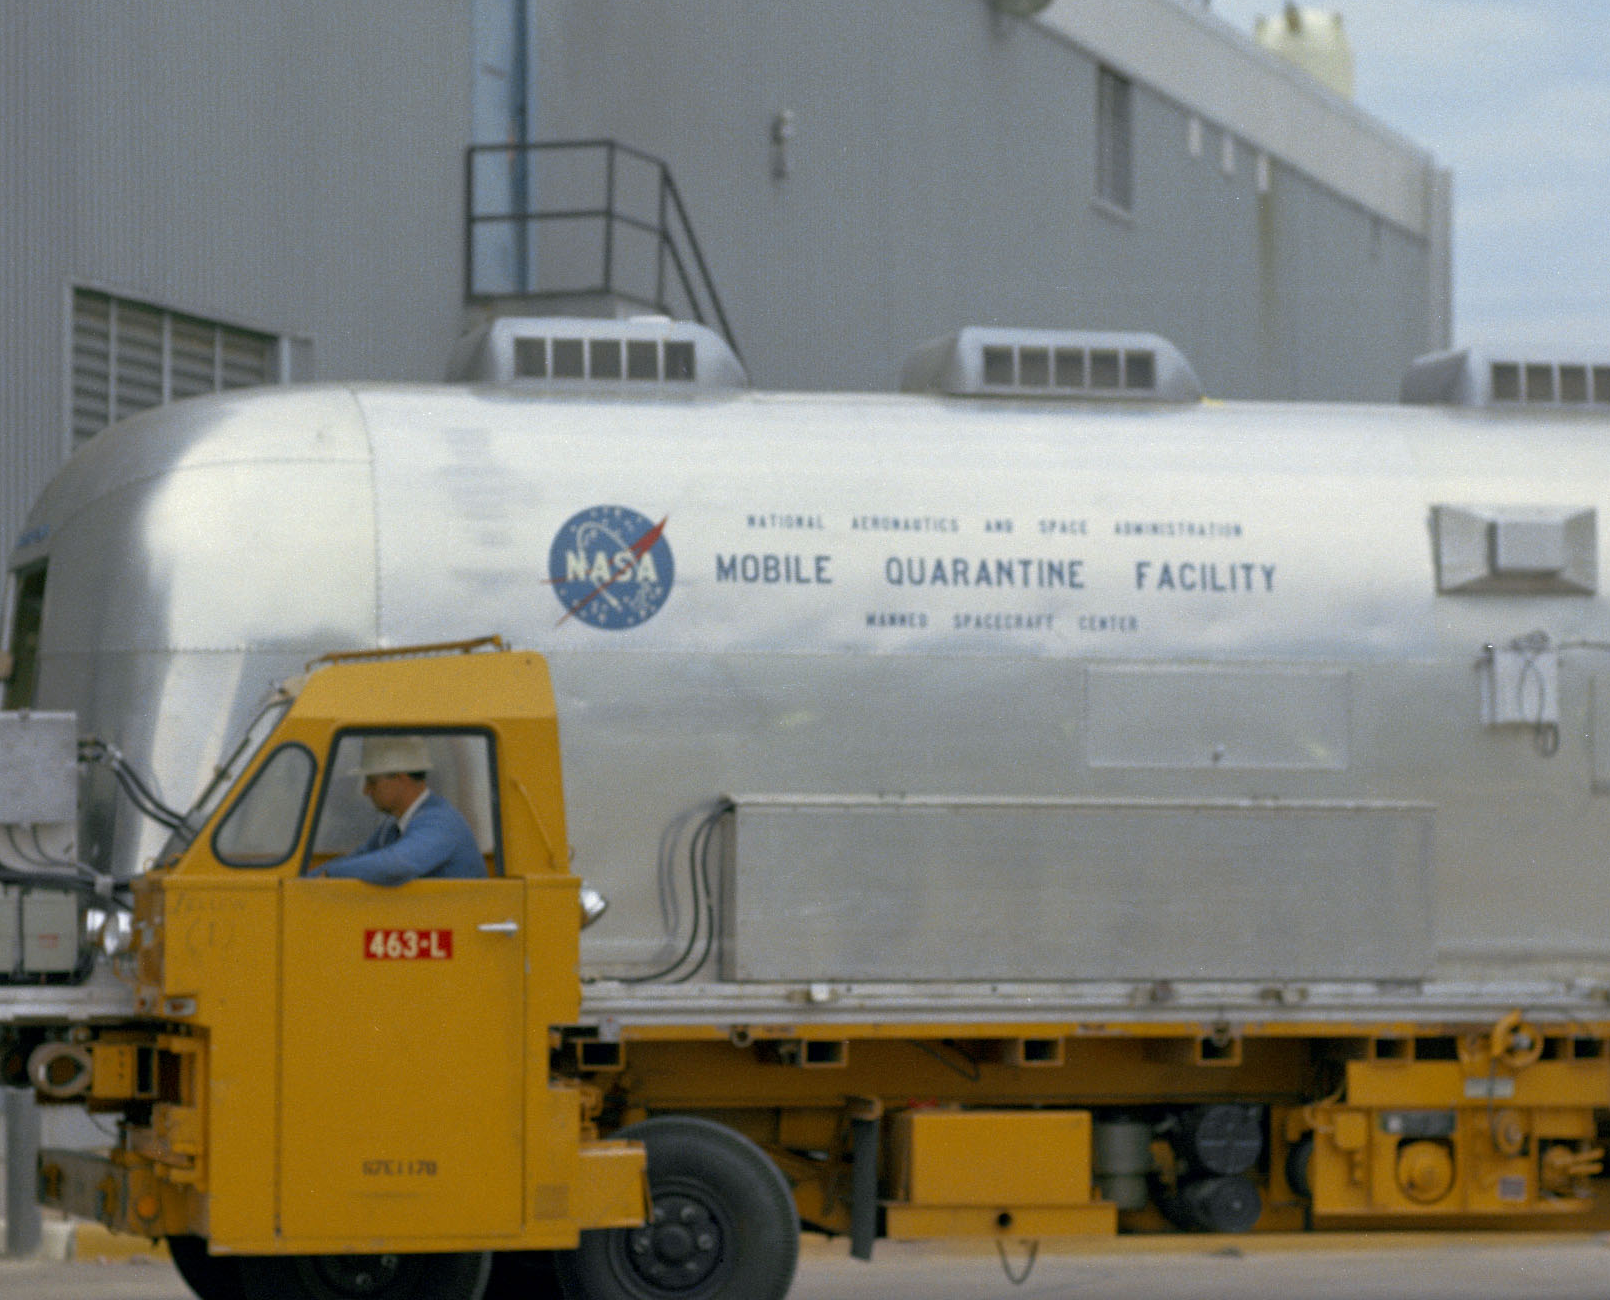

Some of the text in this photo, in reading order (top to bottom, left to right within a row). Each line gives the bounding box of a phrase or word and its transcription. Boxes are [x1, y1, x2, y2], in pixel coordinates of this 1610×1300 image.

[747, 513, 1242, 537] NATIONAL AERONAUTICS AND SPACE ADMINISTRATION
[565, 549, 659, 583] NASA
[716, 553, 1276, 592] MOBILE QUARANTINE FACILITY
[866, 612, 1138, 631] MANNED SPACECRAFT CENTER
